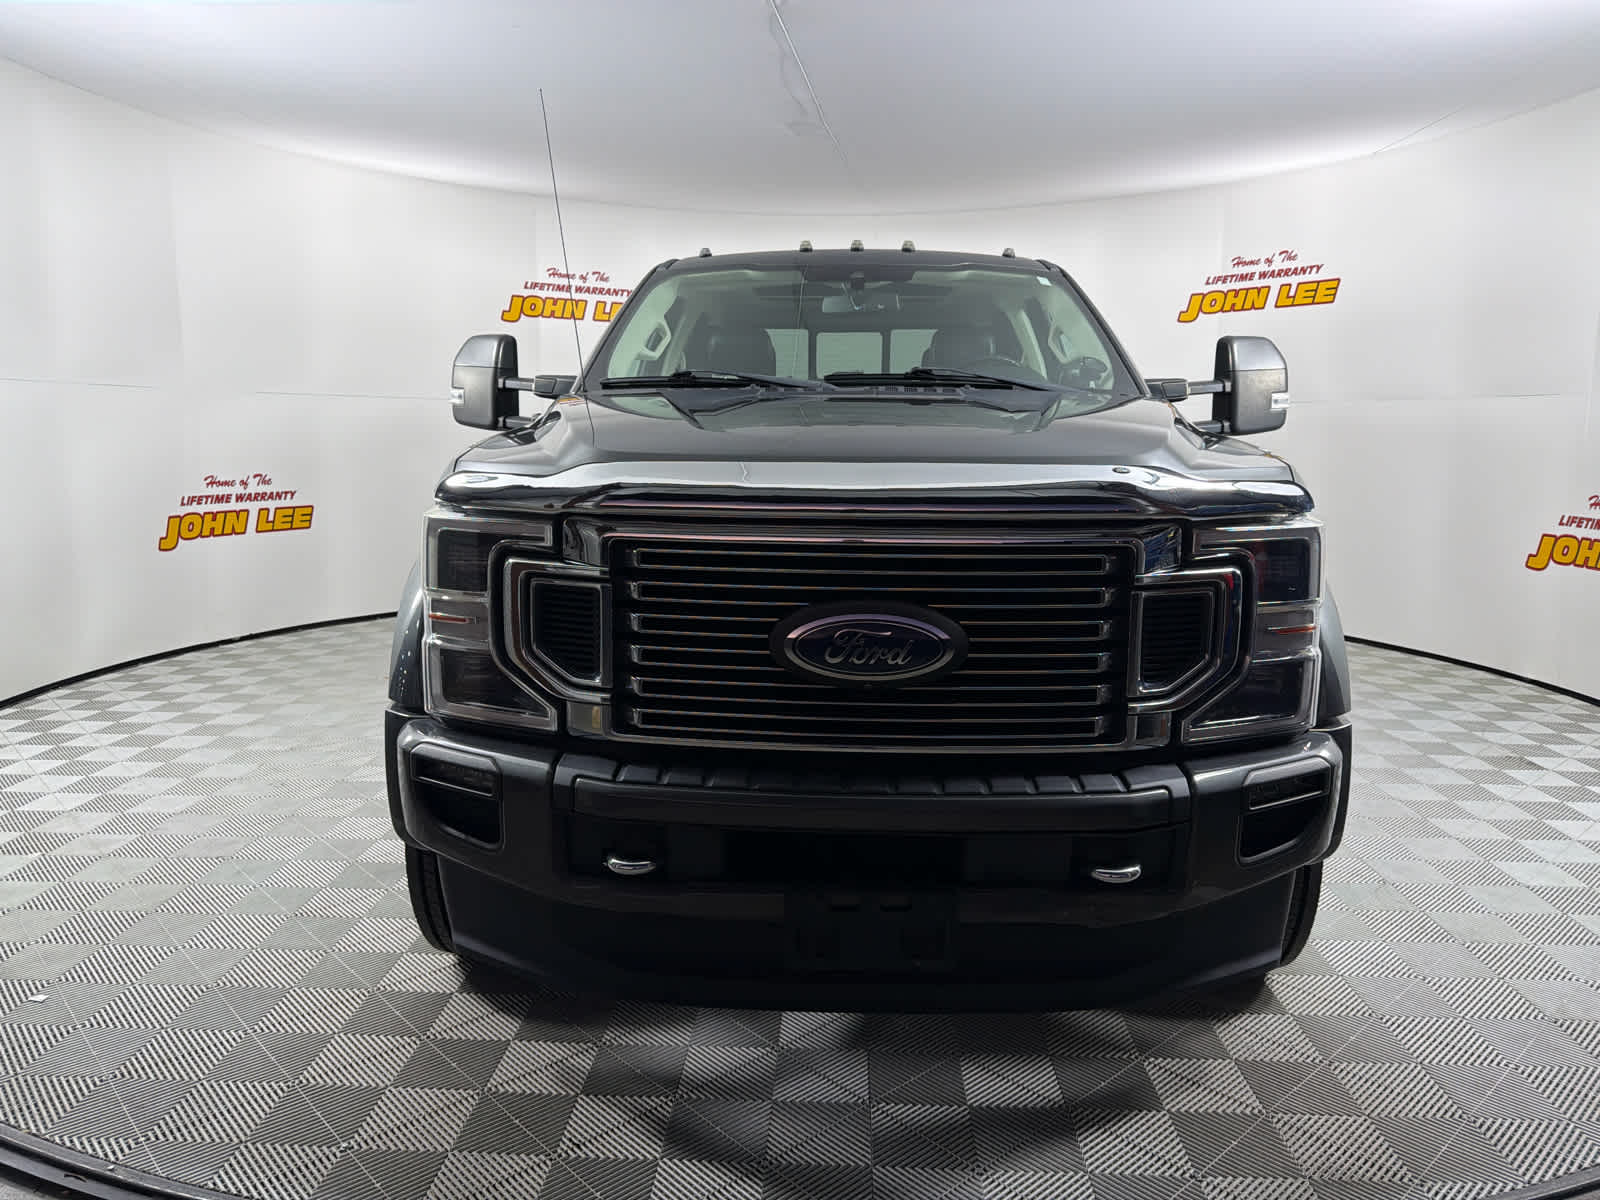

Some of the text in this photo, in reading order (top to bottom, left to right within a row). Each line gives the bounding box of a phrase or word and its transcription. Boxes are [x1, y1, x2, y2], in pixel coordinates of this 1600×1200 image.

[1232, 250, 1298, 268] Home of The
[579, 272, 588, 283] of
[592, 271, 610, 282] The
[1205, 264, 1324, 286] LIFETIME WARRANTY
[524, 281, 633, 297] LIFETIME WARRANTY
[501, 295, 587, 323] JOHN
[1177, 278, 1340, 323] JOHN LEE
[204, 473, 272, 489] Home of The
[180, 490, 296, 506] LIFETIME WARRANTY
[158, 505, 314, 551] JOHN LEE
[1525, 533, 1600, 571] JOH
[824, 628, 915, 665] Ford
